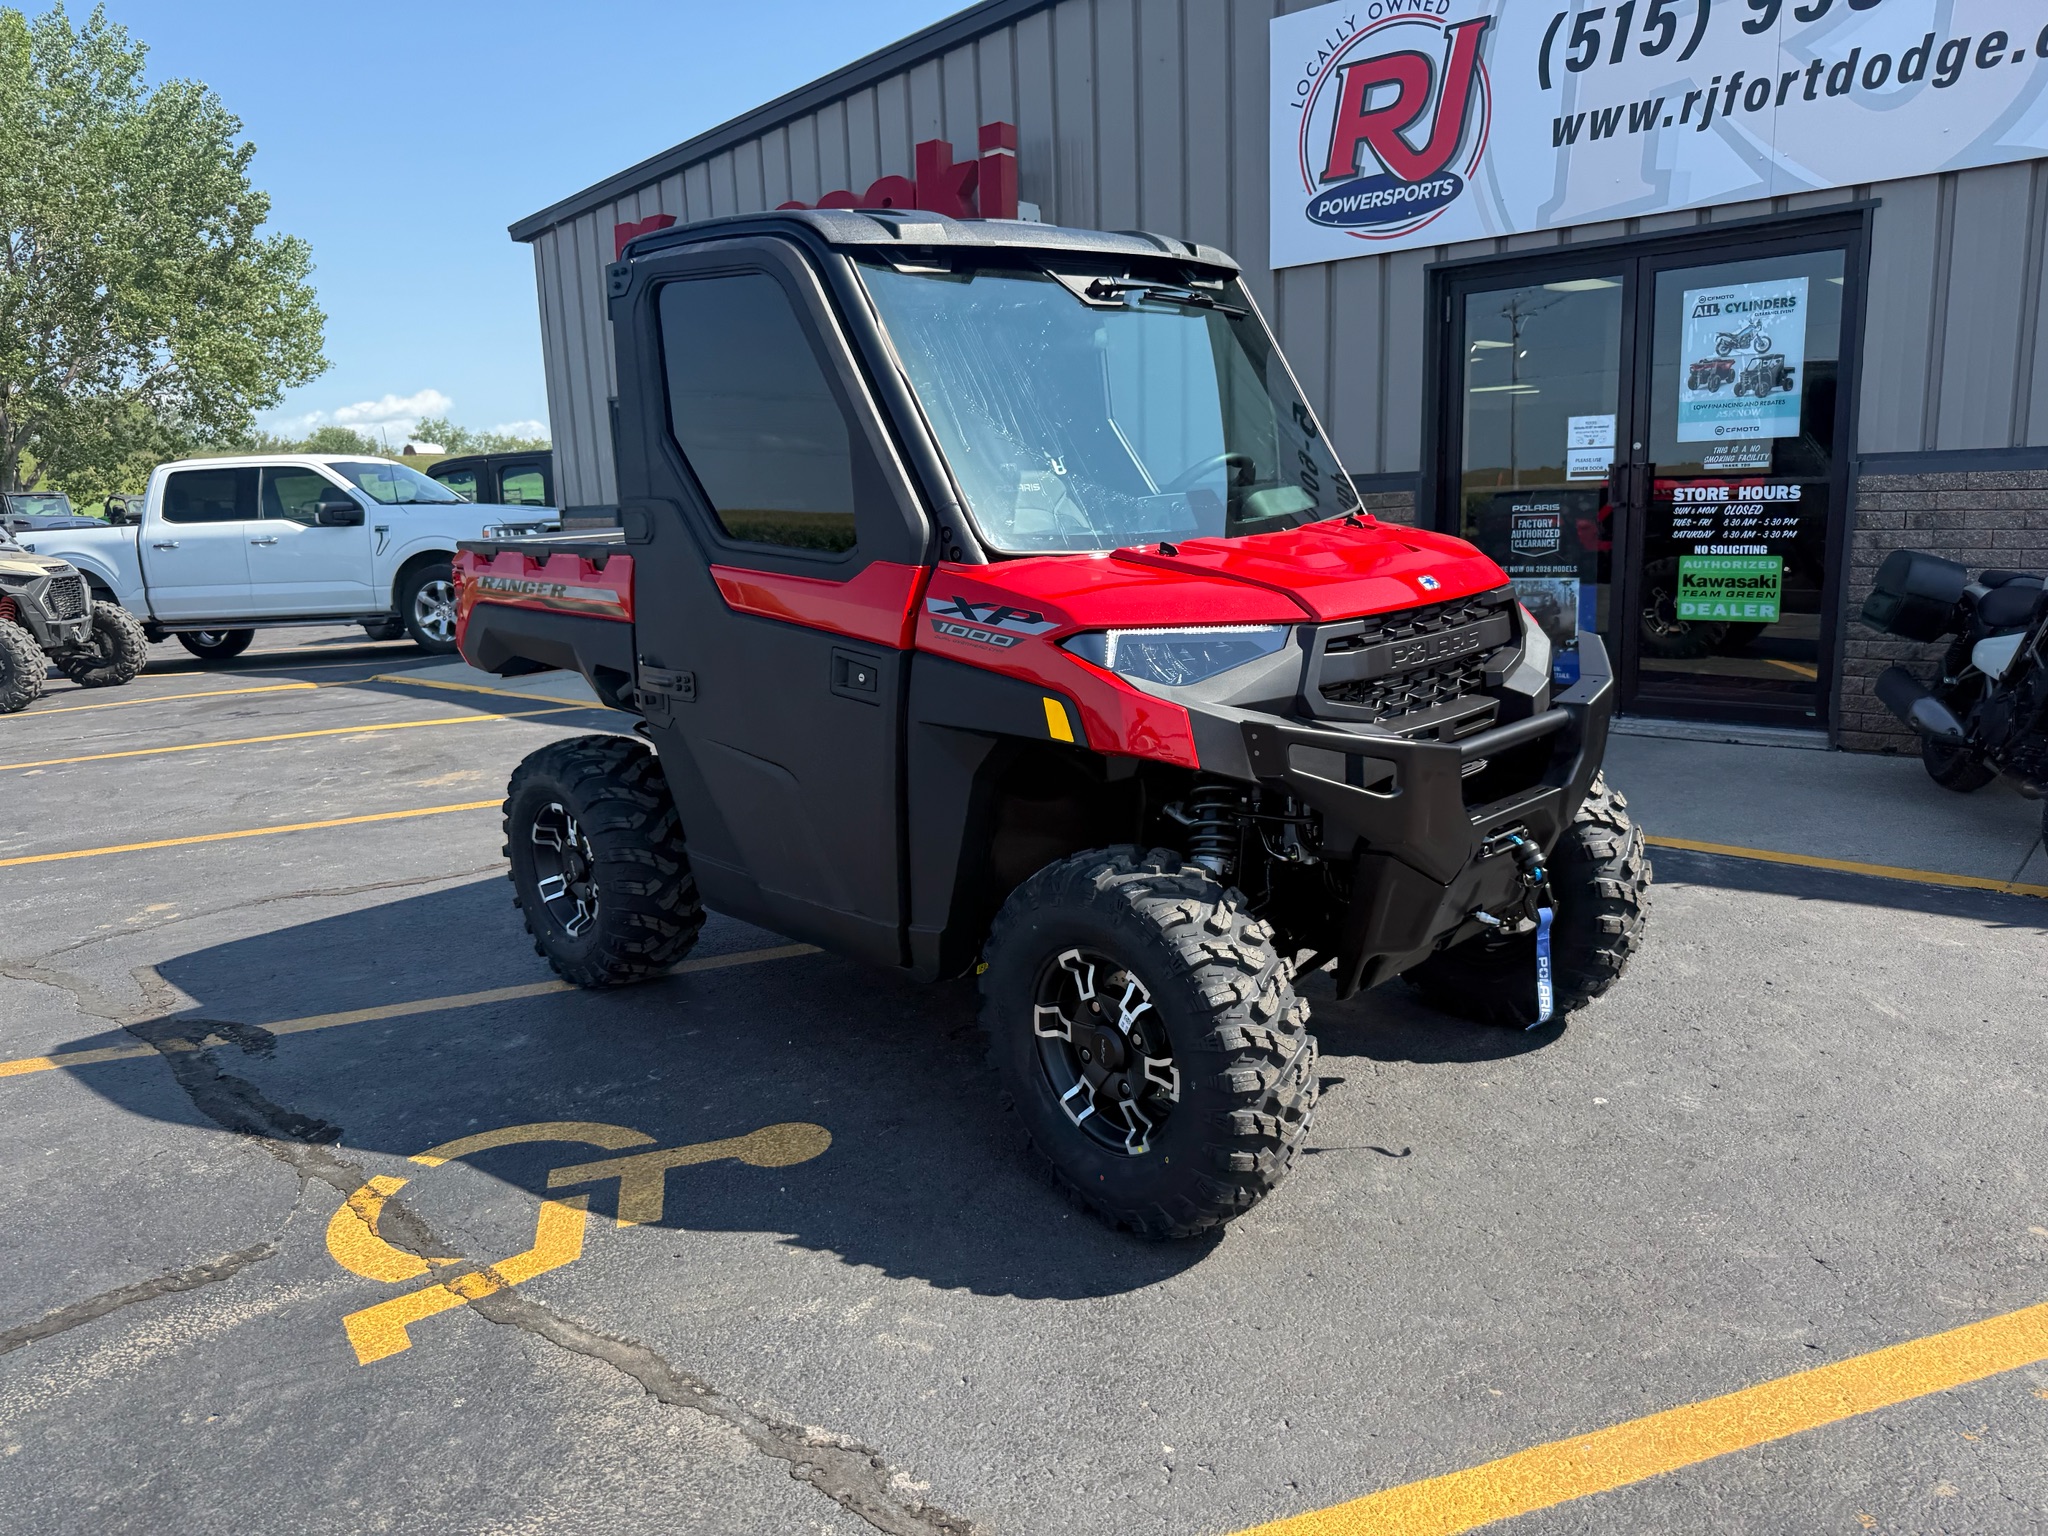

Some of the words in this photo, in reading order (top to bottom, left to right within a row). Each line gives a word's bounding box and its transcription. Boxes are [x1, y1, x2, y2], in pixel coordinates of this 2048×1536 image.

[1290, 14, 1356, 109] LOCALLY
[1368, 0, 1450, 20] OWNED
[1319, 15, 1493, 185] RJ
[1318, 179, 1454, 217] POWERSPORTS
[1694, 304, 1718, 317] ALL
[1725, 297, 1796, 313] CYLINDERS
[1713, 446, 1728, 454] THIS
[1731, 445, 1739, 453] IS
[1741, 445, 1747, 453] A
[1750, 445, 1761, 453] NO
[1704, 455, 1735, 463] SMOKING
[1738, 453, 1769, 462] FACILITY
[1673, 487, 1730, 501] STORE
[1738, 485, 1801, 500] HOURS
[1512, 504, 1560, 512] POLARIS
[1673, 506, 1691, 515] SUN
[1696, 506, 1718, 514] MON
[1724, 505, 1763, 515] CLOSED
[1517, 518, 1553, 529] FACTORY
[1697, 518, 1713, 526] FRI
[1740, 518, 1757, 526] AM
[1782, 518, 1800, 526] PM
[1511, 529, 1560, 539] AUTHORIZED
[1672, 530, 1715, 538] SATURDAY
[1740, 530, 1756, 538] AM
[1781, 530, 1798, 538] PM
[1514, 539, 1556, 548] CLEARANCE
[1694, 545, 1708, 554] NO
[1710, 544, 1768, 554] SOLICITING
[1509, 565, 1524, 573] NOW
[1525, 565, 1534, 573] ON
[1552, 565, 1578, 573] MODELS
[1683, 560, 1778, 569] AUTHORIZED
[480, 576, 567, 598] RANGER
[1682, 574, 1777, 589] Kawasaki
[1682, 589, 1721, 598] TEAM
[1725, 590, 1776, 599] GREEN
[930, 595, 1044, 625] XP
[1681, 603, 1776, 618] DEALER
[939, 622, 1015, 647] 1000
[1391, 631, 1480, 669] POLARIS
[1538, 956, 1553, 1022] POLARIS
